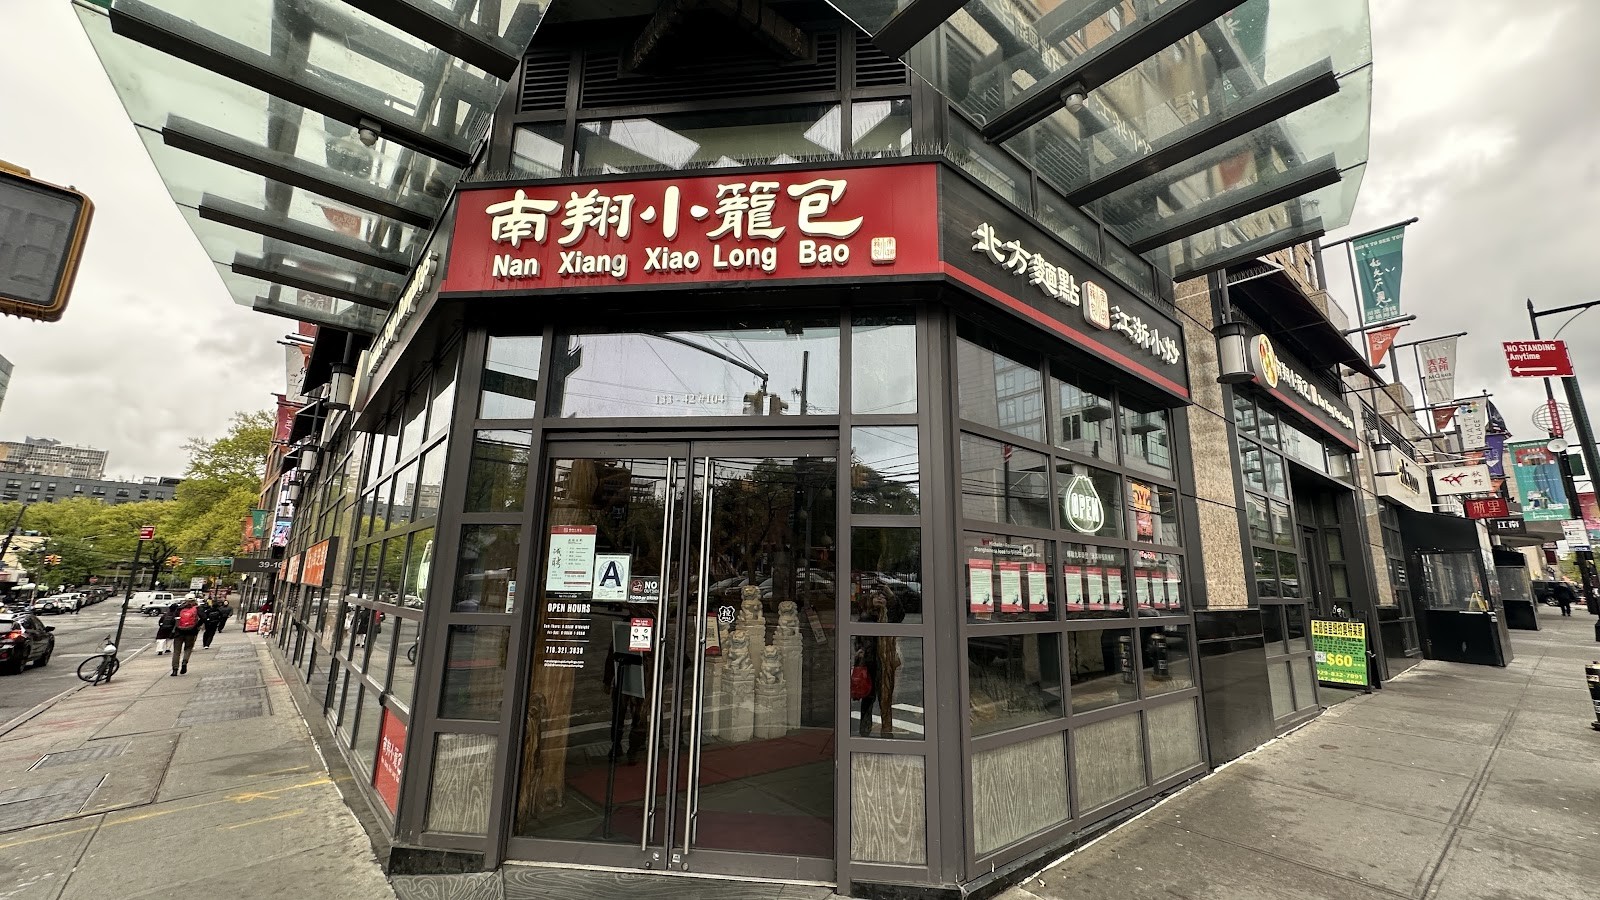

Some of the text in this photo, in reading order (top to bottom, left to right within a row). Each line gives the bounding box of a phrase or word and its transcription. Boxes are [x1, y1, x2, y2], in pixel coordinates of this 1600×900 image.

[492, 254, 539, 277] Nan
[557, 251, 627, 278] Xiang
[643, 247, 700, 272] Xiao
[713, 244, 777, 272] Long
[799, 239, 850, 266] Bao
[971, 222, 1080, 307] 北方麵點
[1506, 343, 1556, 352] NO STANDING
[1509, 353, 1541, 361] Anytime
[1464, 418, 1474, 445] HYATT
[1474, 419, 1483, 440] PLACE
[1071, 492, 1100, 522] OPEN
[1497, 520, 1519, 529] 江南
[599, 560, 621, 587] A
[645, 581, 657, 589] NO
[547, 603, 591, 613] OPEN HOURS
[1326, 653, 1353, 668] $60
